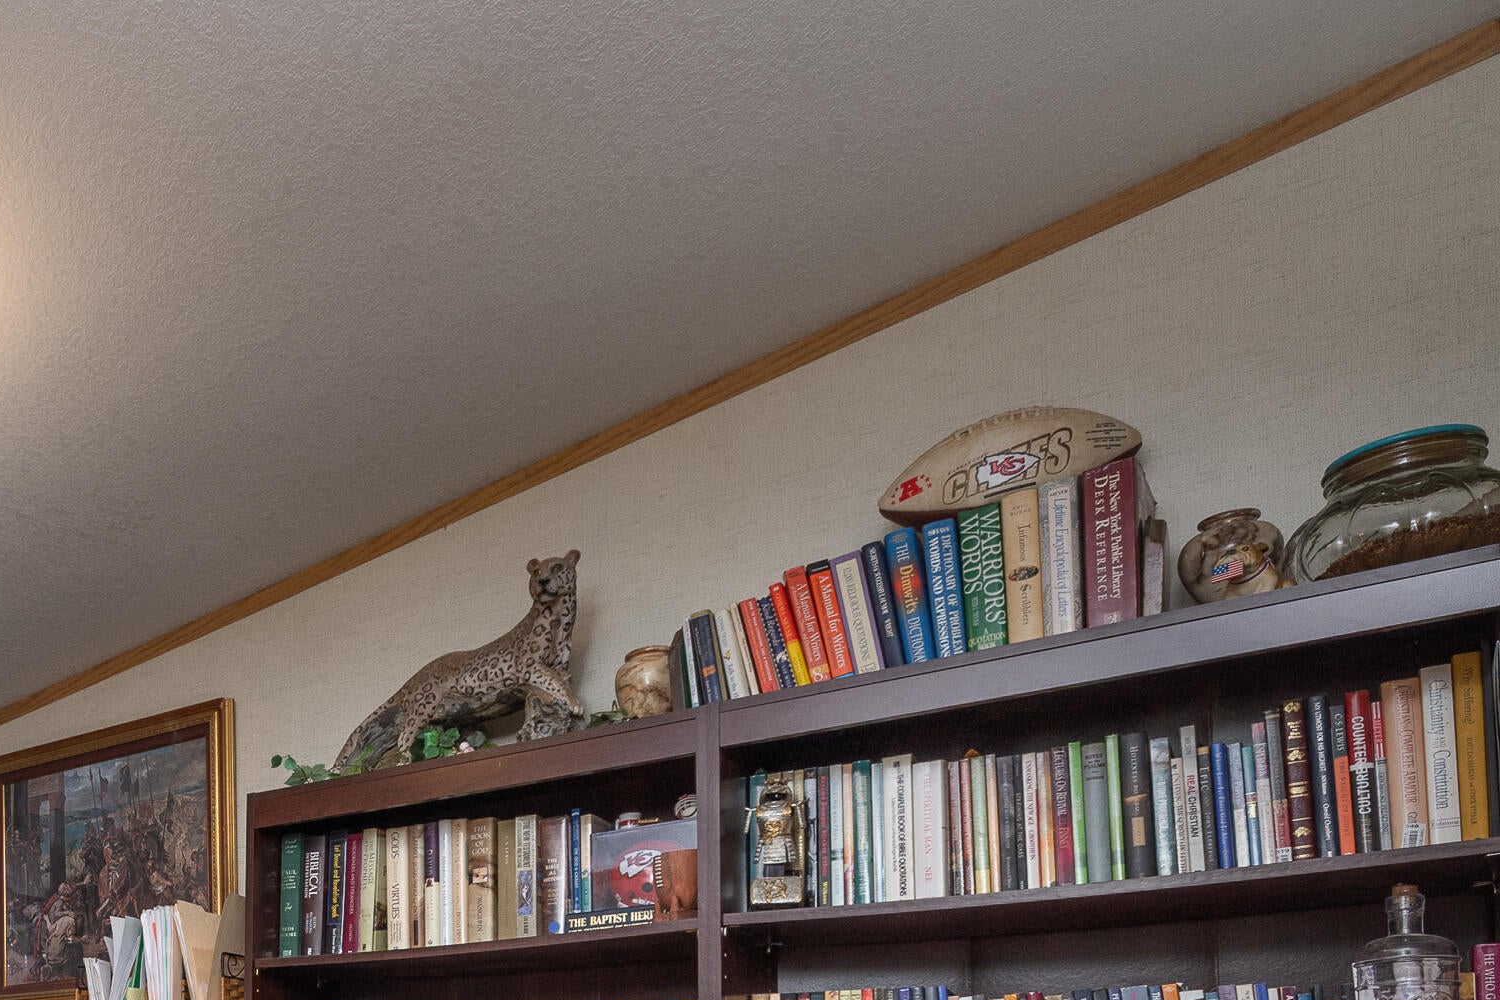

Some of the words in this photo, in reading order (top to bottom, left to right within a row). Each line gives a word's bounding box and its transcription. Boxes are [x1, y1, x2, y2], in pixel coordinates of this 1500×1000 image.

[1095, 476, 1108, 514] DESK
[1109, 492, 1121, 514] New
[1110, 514, 1122, 535] York
[896, 543, 909, 562] THE
[928, 537, 941, 573] WORDS
[941, 535, 956, 591] DICTIONARY
[960, 513, 982, 595] WORDS
[1095, 519, 1110, 601] REFERENCE
[1111, 535, 1123, 562] Public
[932, 576, 944, 594] AND
[979, 509, 1006, 625] WARRIORS'
[1110, 562, 1123, 599] Library
[821, 584, 838, 619] Manual
[899, 563, 918, 615] Dimwit's
[828, 619, 842, 633] for
[935, 597, 950, 659] EXPRESSIONS
[808, 632, 822, 662] Writers
[833, 633, 849, 669] Writers
[1427, 680, 1448, 735] Christianity
[1335, 728, 1345, 751] LEWIS
[1351, 716, 1367, 763] COUNTER
[1186, 775, 1196, 795] REAL
[1432, 750, 1453, 809] Constitution
[1187, 796, 1199, 838] CHRISTIAN
[308, 851, 320, 898] BIBLICAL
[568, 918, 587, 928] THE
[590, 914, 627, 925] BAPTIST
[1484, 953, 1494, 966] HE
[1484, 967, 1495, 991] WHO
